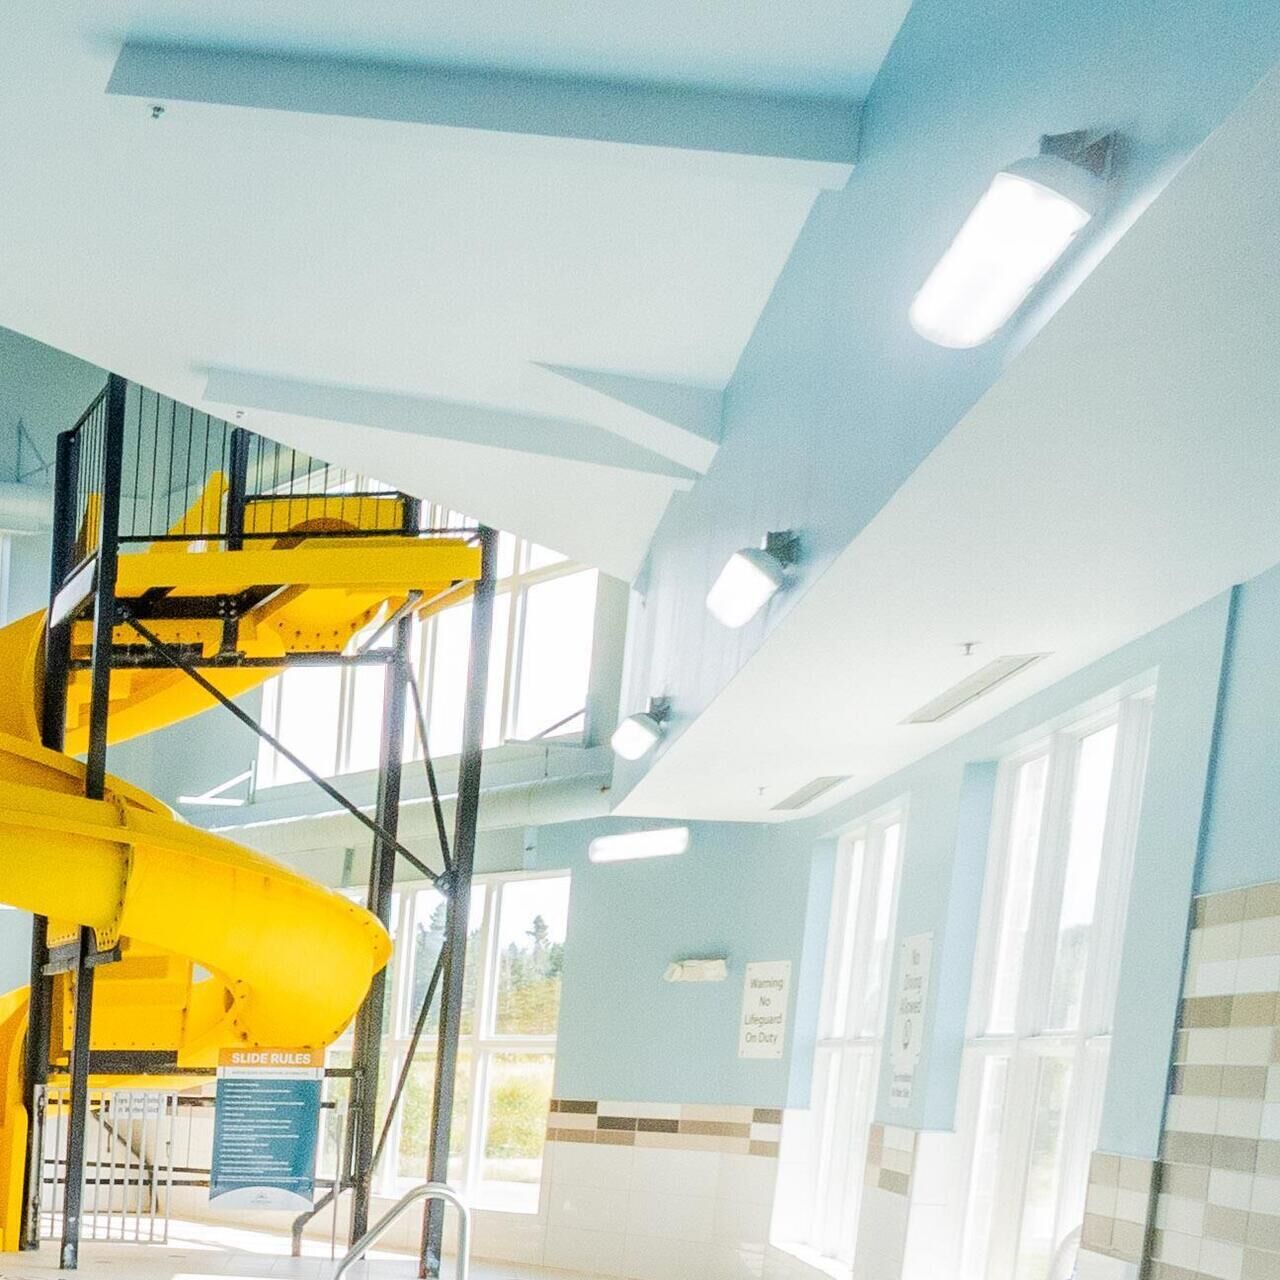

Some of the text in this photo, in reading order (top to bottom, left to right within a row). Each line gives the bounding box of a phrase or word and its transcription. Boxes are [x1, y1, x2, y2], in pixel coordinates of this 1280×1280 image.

[750, 977, 783, 991] Warning
[760, 997, 771, 1007] No
[744, 1013, 782, 1028] Lifeguard
[745, 1031, 777, 1045] On Duty
[232, 1053, 311, 1065] SLIDE RULES
